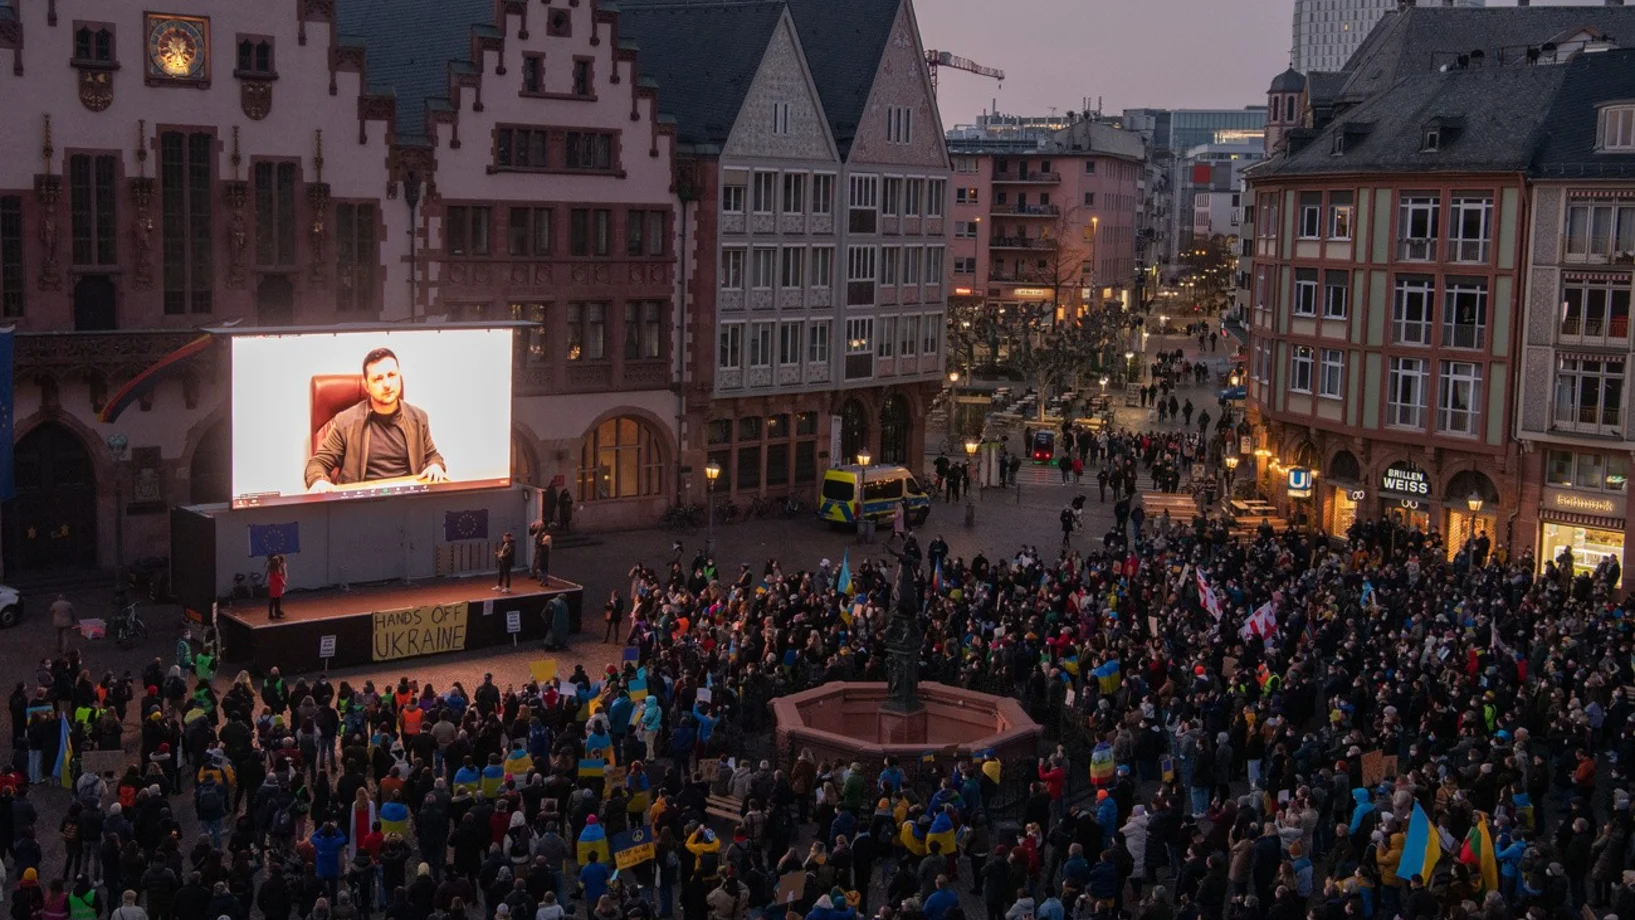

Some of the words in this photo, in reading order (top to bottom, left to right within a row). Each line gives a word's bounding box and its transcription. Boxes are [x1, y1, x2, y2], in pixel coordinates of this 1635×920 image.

[1289, 470, 1306, 488] U
[1387, 468, 1424, 481] BRILLEN
[1383, 477, 1428, 494] WEISS
[374, 609, 422, 630] HANDS
[431, 605, 464, 624] OFF
[375, 625, 465, 658] UKRAINE
